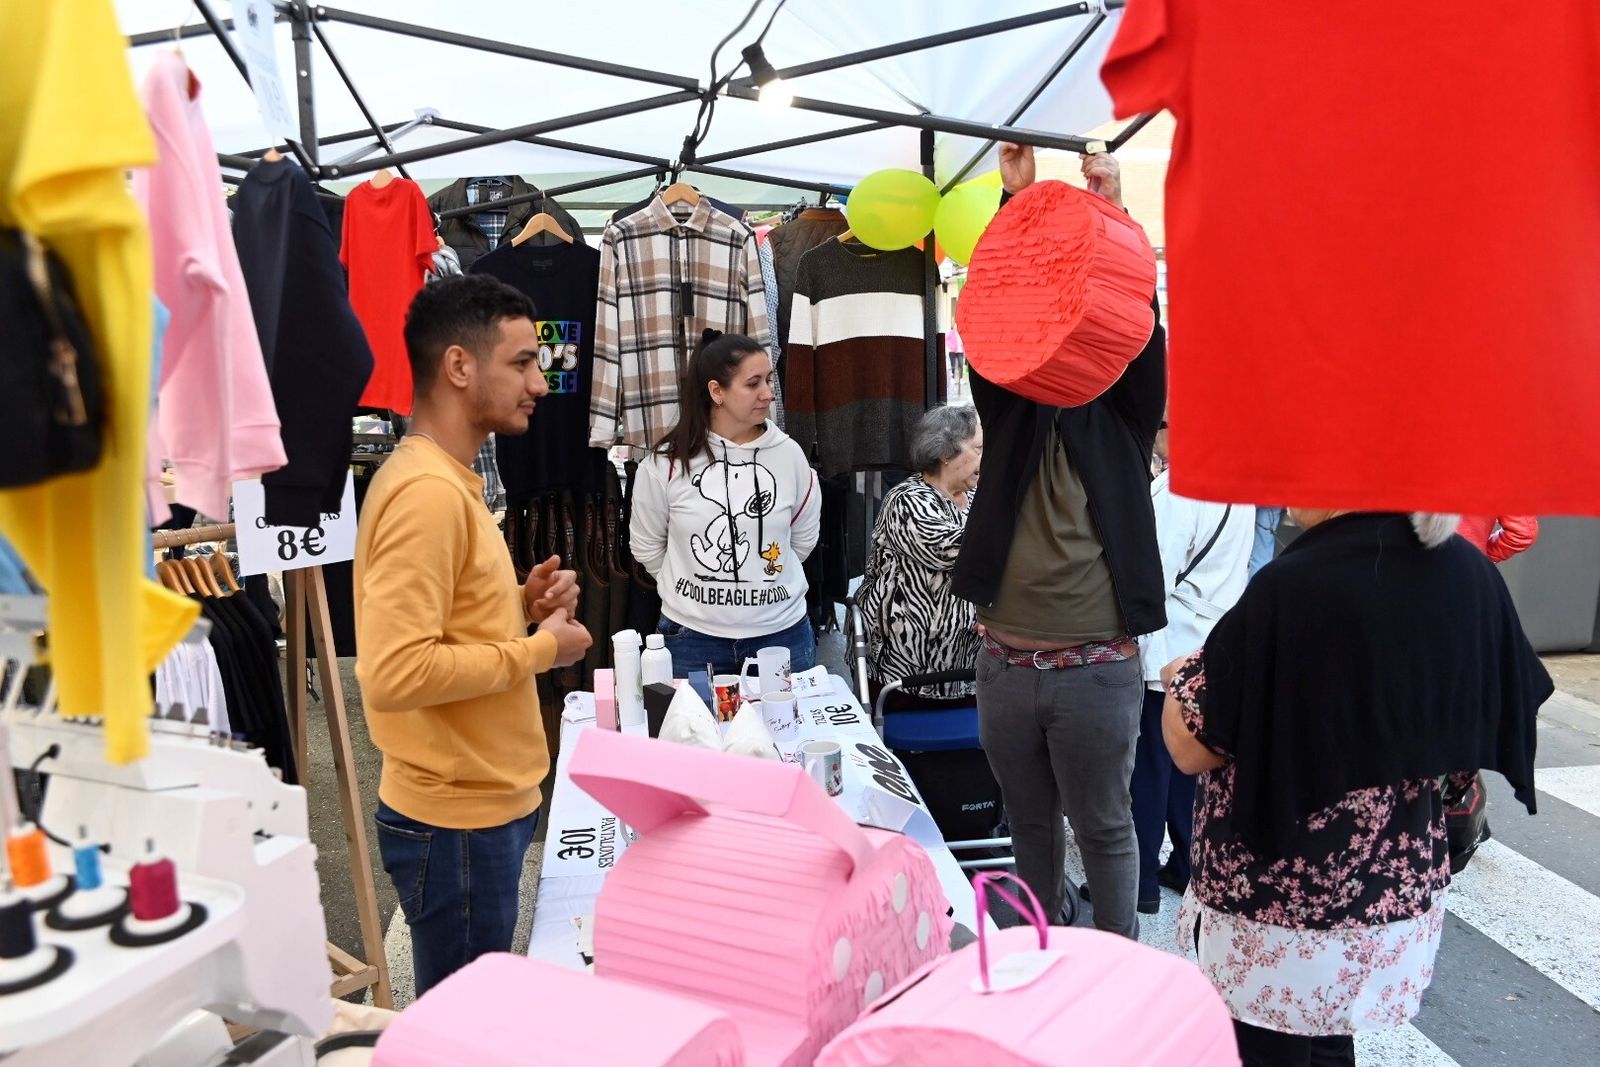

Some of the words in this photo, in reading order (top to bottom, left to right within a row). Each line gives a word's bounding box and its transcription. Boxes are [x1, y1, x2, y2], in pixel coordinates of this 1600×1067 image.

[537, 343, 578, 371] 0'S
[545, 374, 577, 391] SIC
[277, 526, 327, 561] 8€
[675, 577, 791, 606] #COOLBEAGLE#COOL
[824, 703, 860, 726] 10€
[961, 801, 994, 812] FORTA
[557, 827, 596, 861] 10€
[598, 817, 616, 868] PANTALONES
